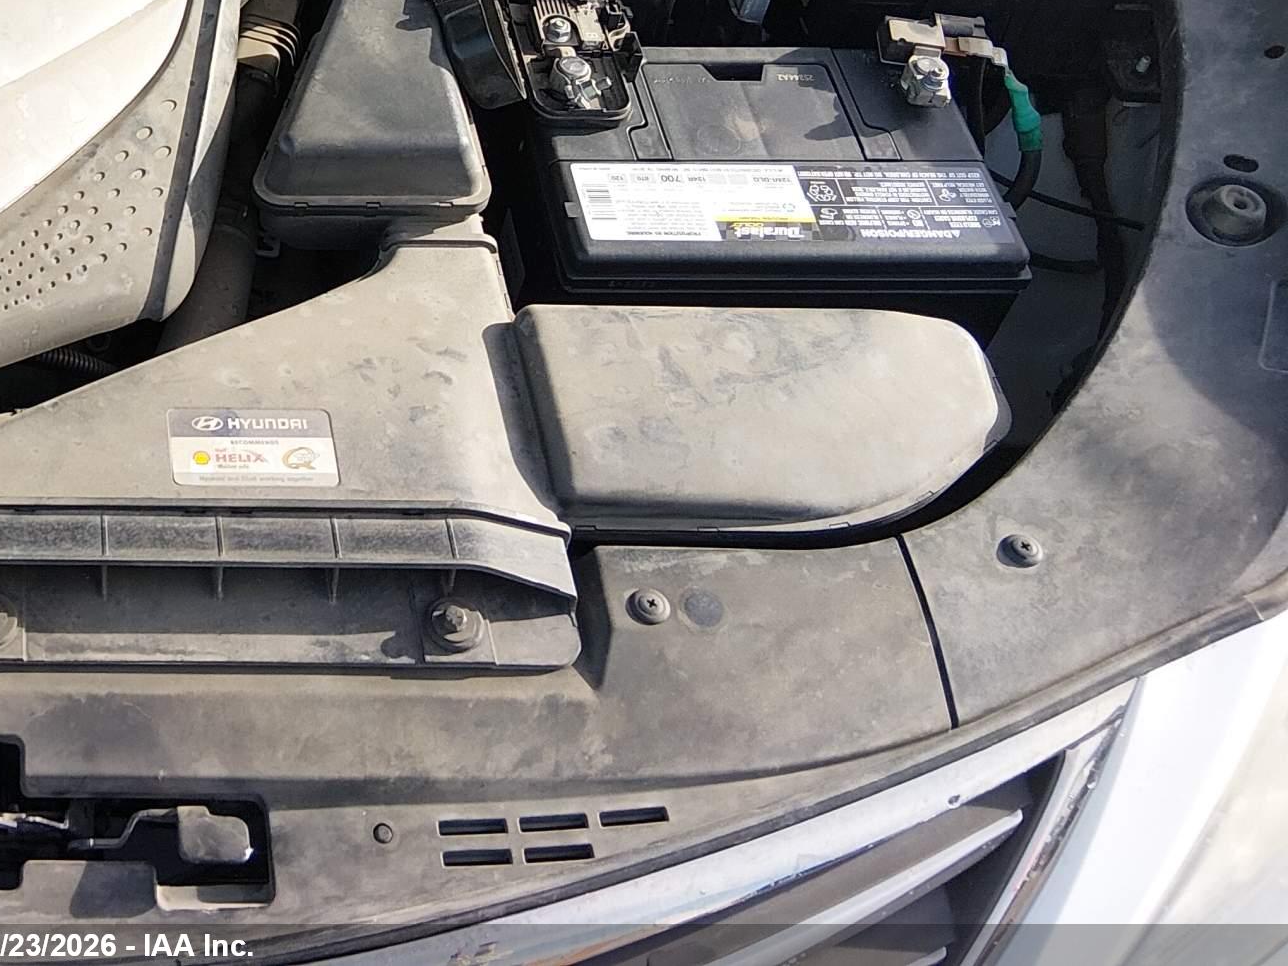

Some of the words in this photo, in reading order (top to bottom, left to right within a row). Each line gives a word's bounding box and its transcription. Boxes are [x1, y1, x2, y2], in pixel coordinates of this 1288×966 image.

[660, 175, 680, 183] 700
[733, 226, 805, 239] Duralast
[227, 417, 308, 430] HYUNDAI
[215, 453, 266, 463] HELIX
